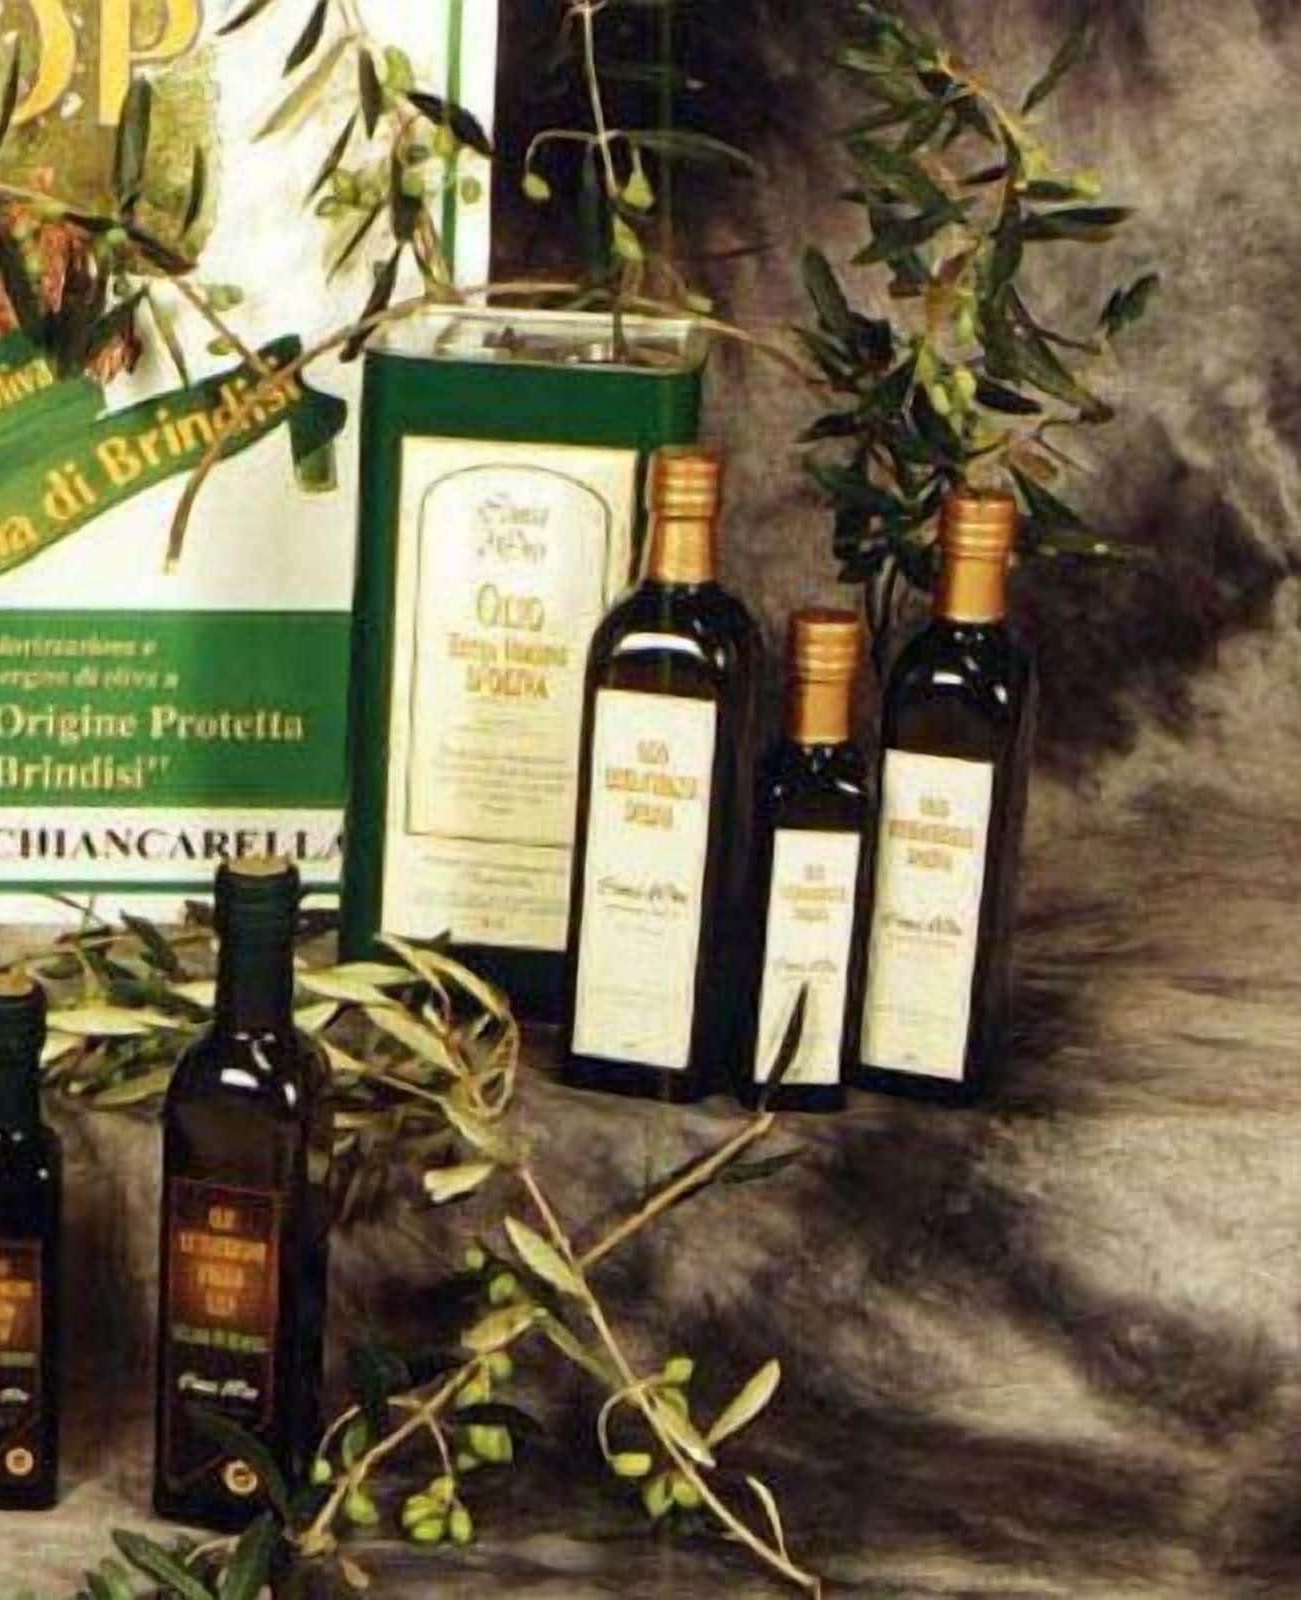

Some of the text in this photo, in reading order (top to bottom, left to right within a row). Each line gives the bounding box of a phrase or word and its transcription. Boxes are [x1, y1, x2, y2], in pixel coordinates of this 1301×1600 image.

[43, 460, 98, 522] di
[476, 583, 546, 634] OLIO
[150, 705, 304, 740] Protetta
